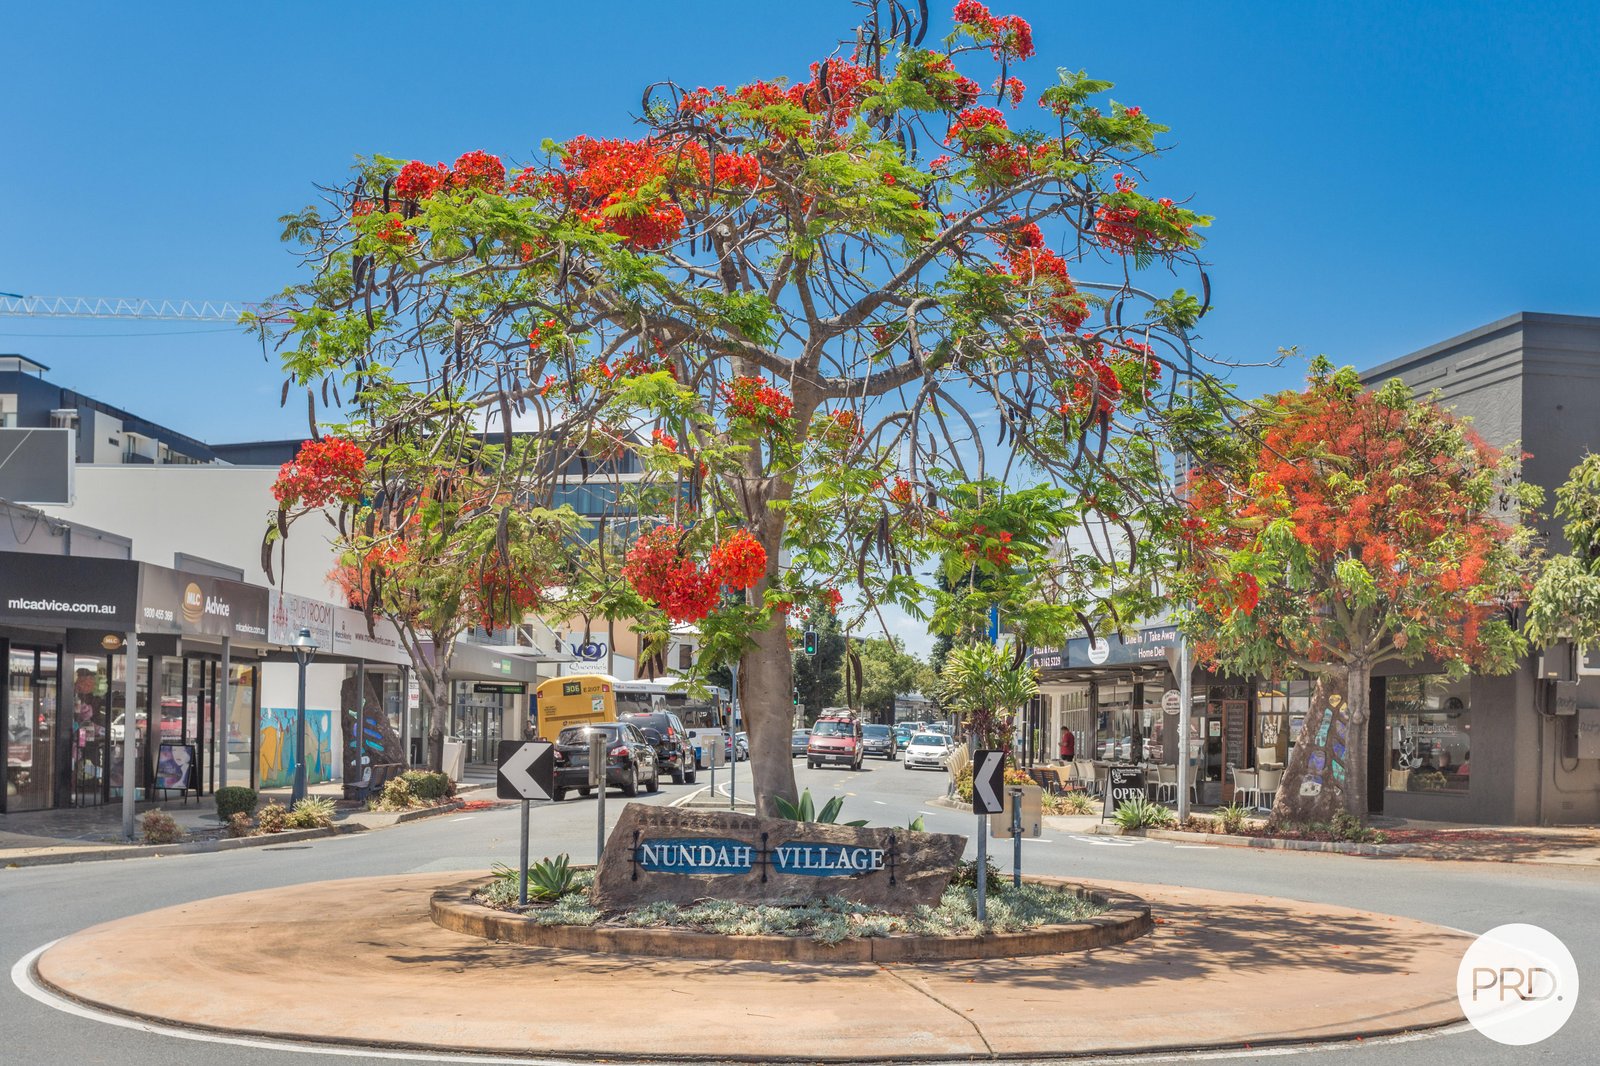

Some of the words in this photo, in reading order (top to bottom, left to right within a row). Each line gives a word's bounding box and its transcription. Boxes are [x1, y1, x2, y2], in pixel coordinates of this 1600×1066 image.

[8, 598, 116, 614] mlcadvice.com.au
[187, 592, 200, 606] MLC
[205, 596, 230, 617] Advice
[144, 607, 155, 618] 1800
[1149, 631, 1161, 642] Take
[1161, 630, 1176, 642] Away
[1138, 648, 1153, 658] Home
[1113, 787, 1144, 800] OPEN
[641, 844, 752, 868] NUNDAH
[775, 847, 886, 871] VILLAGE
